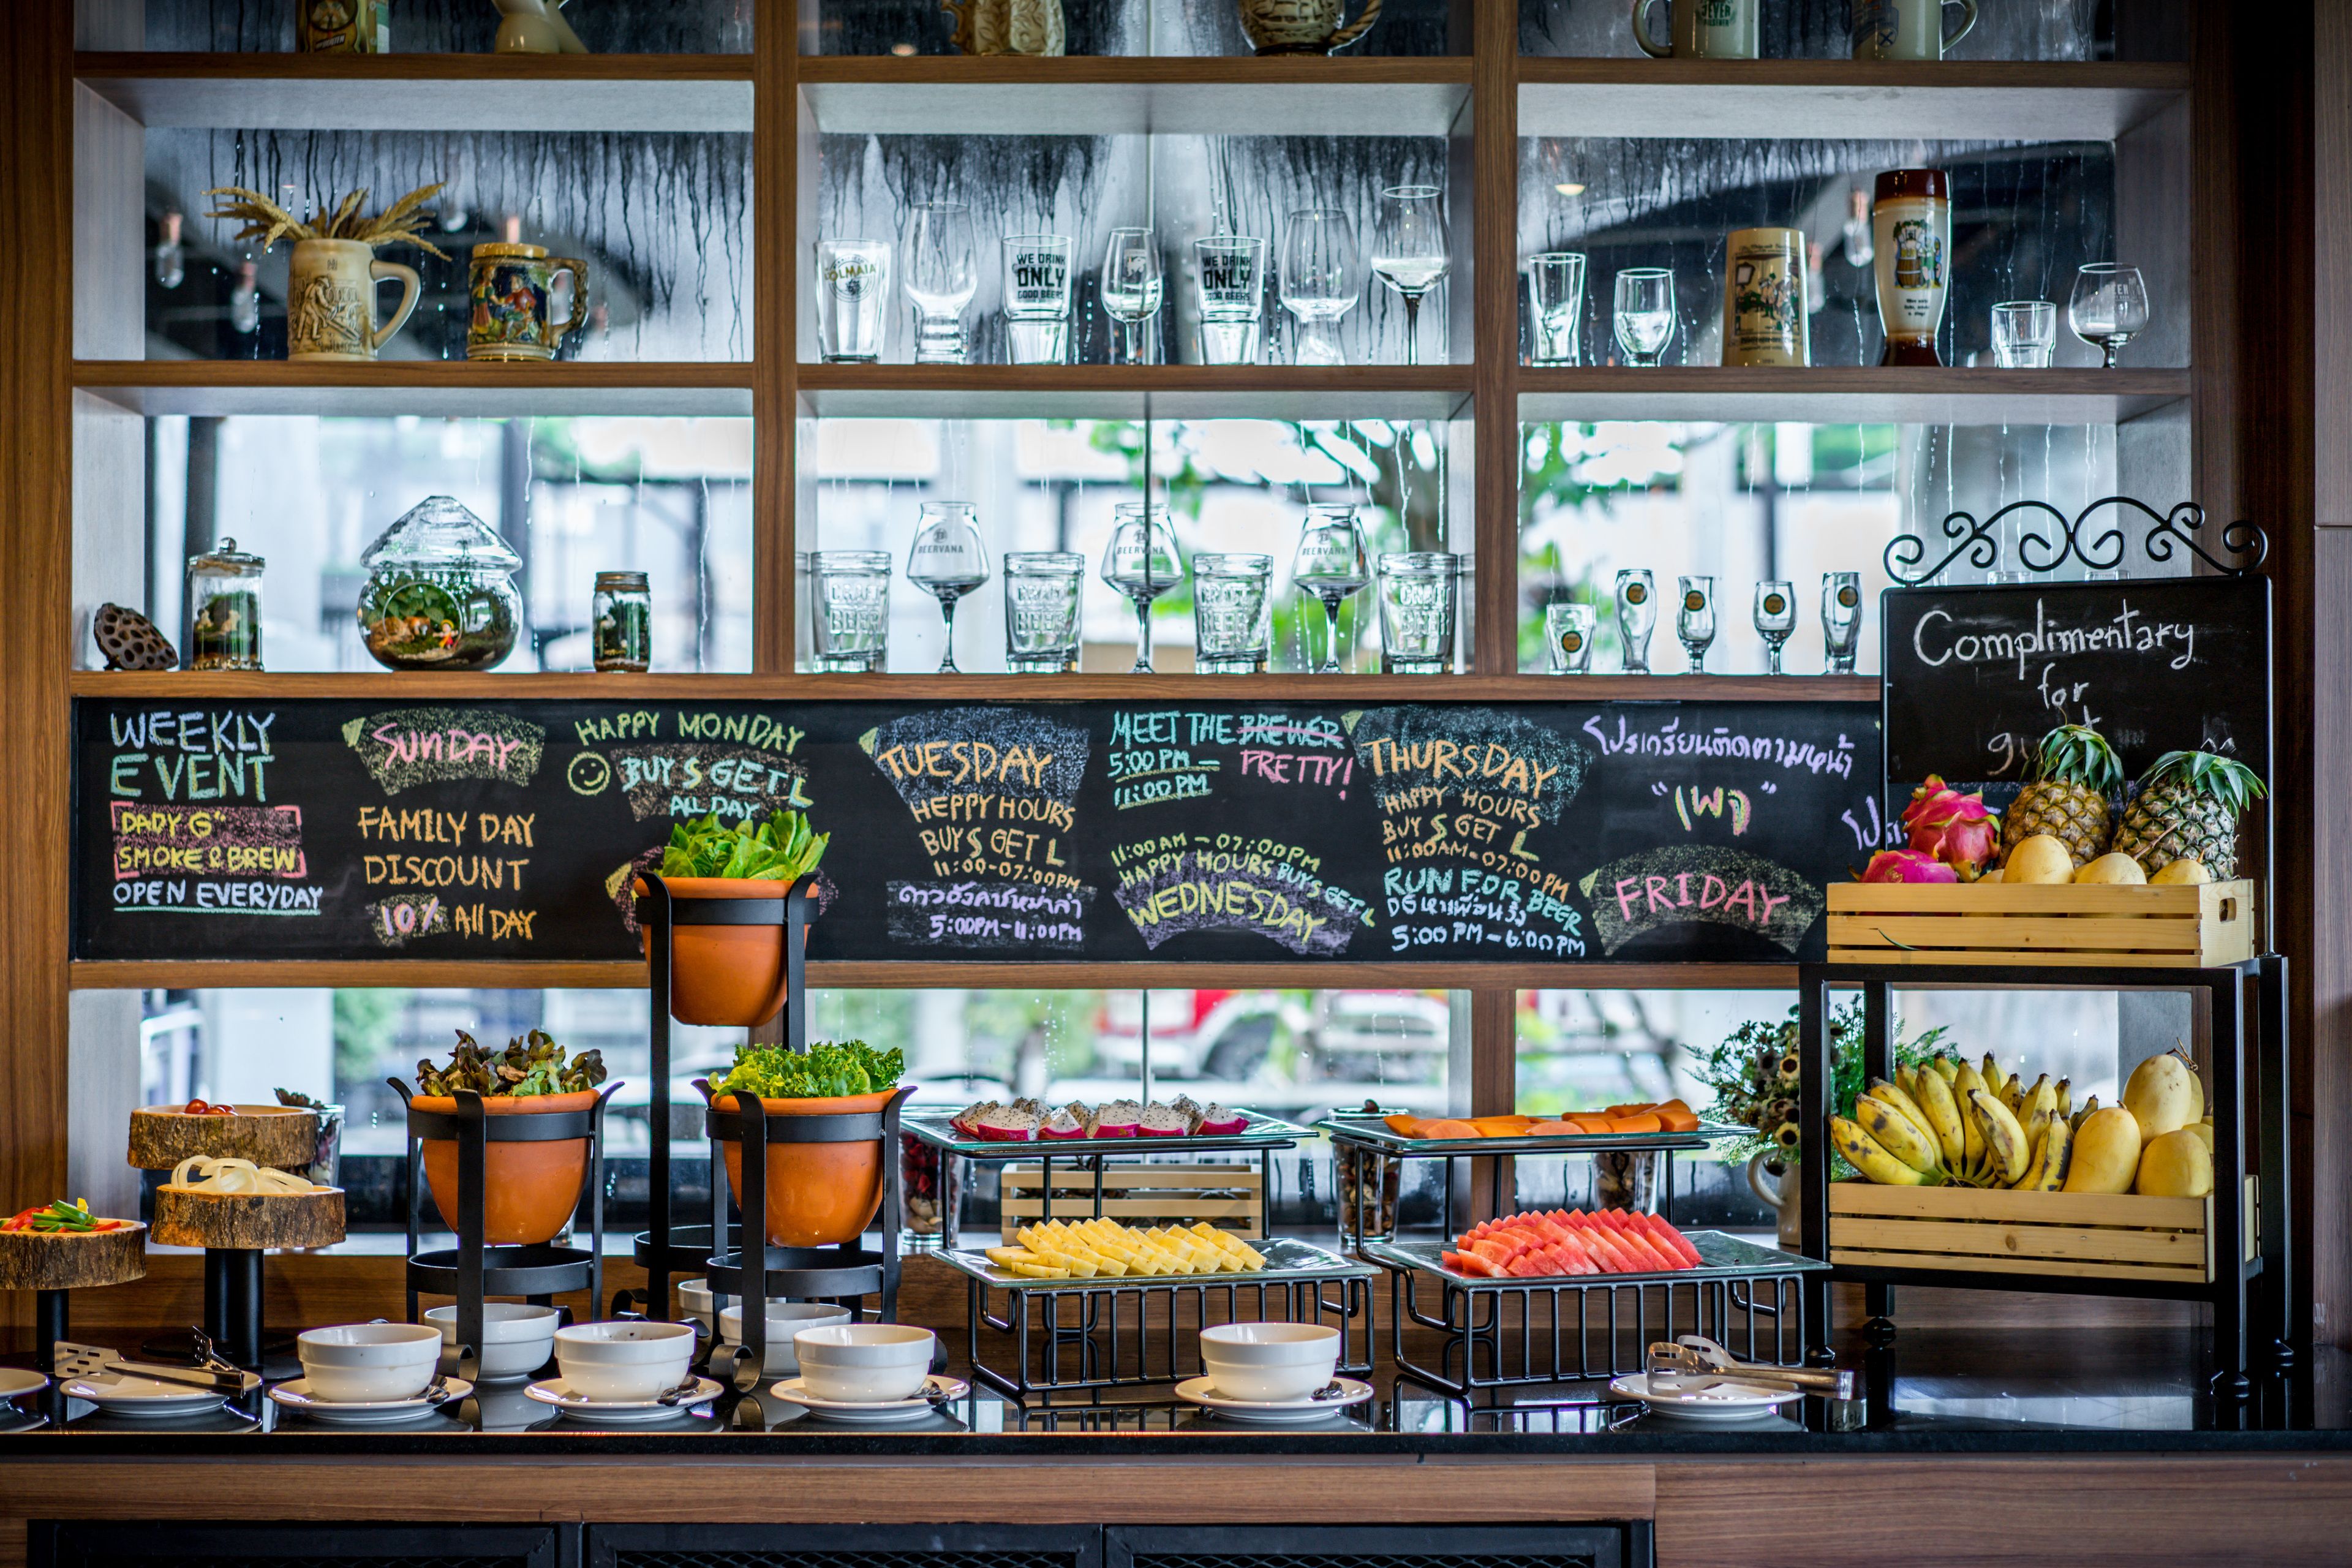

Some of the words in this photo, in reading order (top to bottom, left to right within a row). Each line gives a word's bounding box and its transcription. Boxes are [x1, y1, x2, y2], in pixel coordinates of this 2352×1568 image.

[1702, 3, 1731, 18] JEVER
[1017, 254, 1034, 265] WE
[1038, 254, 1066, 265] DRINK
[1017, 267, 1065, 288] ONLY
[1202, 255, 1218, 267] WE
[1223, 255, 1251, 267] DRINK
[1204, 270, 1251, 289] ONLY
[918, 545, 963, 554] BEERVANA
[1913, 598, 2194, 680] Complimentary
[2037, 663, 2089, 709] for
[111, 710, 274, 755] WEEKLY
[575, 710, 660, 746] HAPPY
[678, 711, 805, 755] MONDAY
[1110, 710, 1181, 750] MEET
[1185, 713, 1238, 745] THE
[111, 752, 274, 802] EVENT
[620, 755, 675, 792] BUY
[709, 759, 788, 795] GET
[876, 740, 1054, 789] TUESDAY
[1360, 737, 1558, 800] THURSDAY
[121, 812, 180, 836] DADY
[358, 806, 467, 846] FAMILY
[480, 813, 535, 847] DAY
[670, 796, 708, 816] ALL
[710, 795, 760, 819] DAY
[910, 793, 995, 823] HEPPY
[999, 797, 1076, 833] HOURS
[1384, 786, 1449, 816] HAPPY
[1461, 788, 1541, 830] HOURS
[919, 825, 963, 856] BUY
[990, 828, 1040, 861] GET
[1382, 816, 1422, 846] BUY
[1455, 813, 1502, 844] GET
[119, 847, 203, 874] SMOKE
[226, 847, 296, 871] BREW
[364, 855, 529, 891] DISCOUNT
[113, 881, 186, 906] OPEN
[197, 882, 323, 910] EVERYDAY
[1119, 851, 1186, 889] HAPPY
[1196, 849, 1273, 878] HOURS
[1277, 862, 1314, 891] BUY
[1324, 886, 1365, 914] GET
[1615, 872, 1790, 925] FRIDAY
[383, 897, 443, 935] 10%
[490, 910, 537, 940] DAY
[1127, 880, 1328, 946] WEDNESDAY
[1384, 867, 1453, 896] RUN
[1461, 869, 1521, 903] FOR
[1526, 889, 1582, 937] BEER
